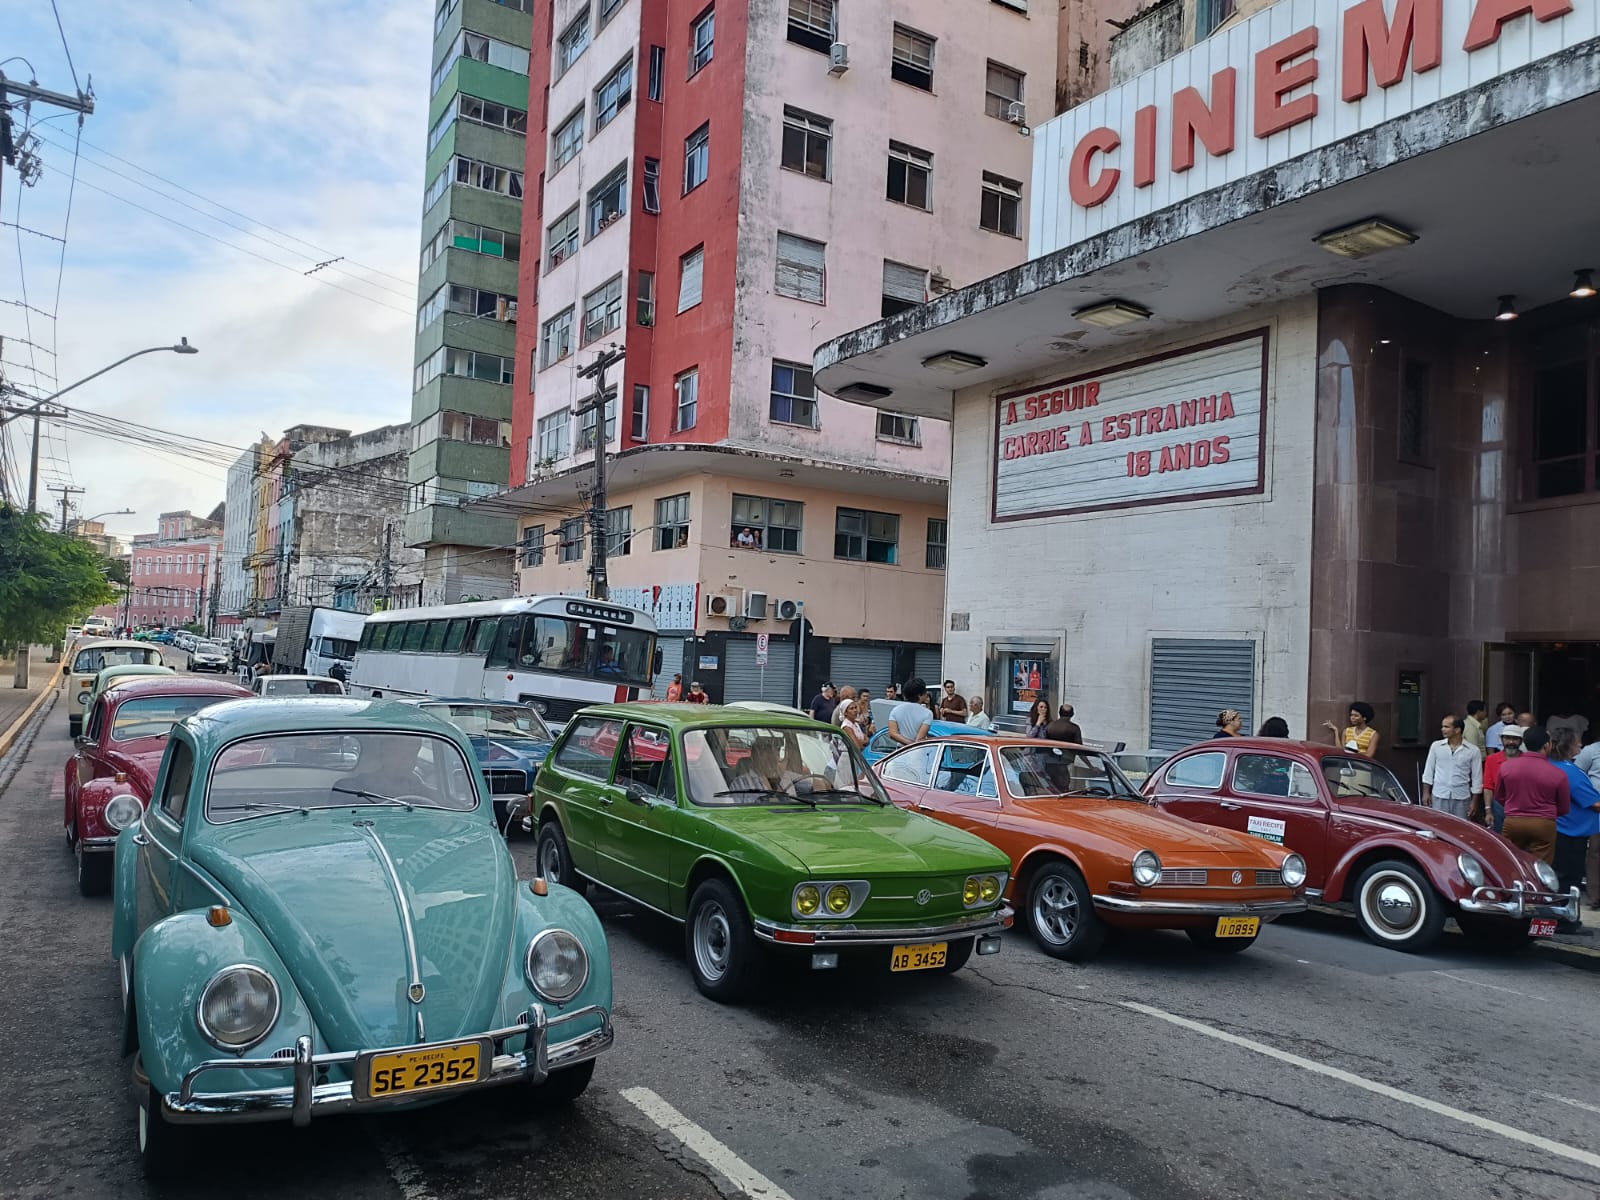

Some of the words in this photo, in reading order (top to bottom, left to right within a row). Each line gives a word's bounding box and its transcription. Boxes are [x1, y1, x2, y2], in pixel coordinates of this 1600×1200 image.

[1005, 401, 1018, 425] A
[1024, 381, 1101, 421] SEGUIR
[1003, 425, 1070, 460] CARRIE
[1079, 421, 1093, 446] A
[1101, 391, 1235, 442] ESTRANHA
[1127, 450, 1151, 477] 18
[1158, 435, 1230, 473] ANOS
[569, 603, 626, 620] GARAGEM
[1228, 924, 1255, 935] 0895
[893, 954, 909, 969] AB
[913, 951, 946, 967] 3452
[374, 1067, 406, 1093] SE
[413, 1057, 476, 1087] 2352
